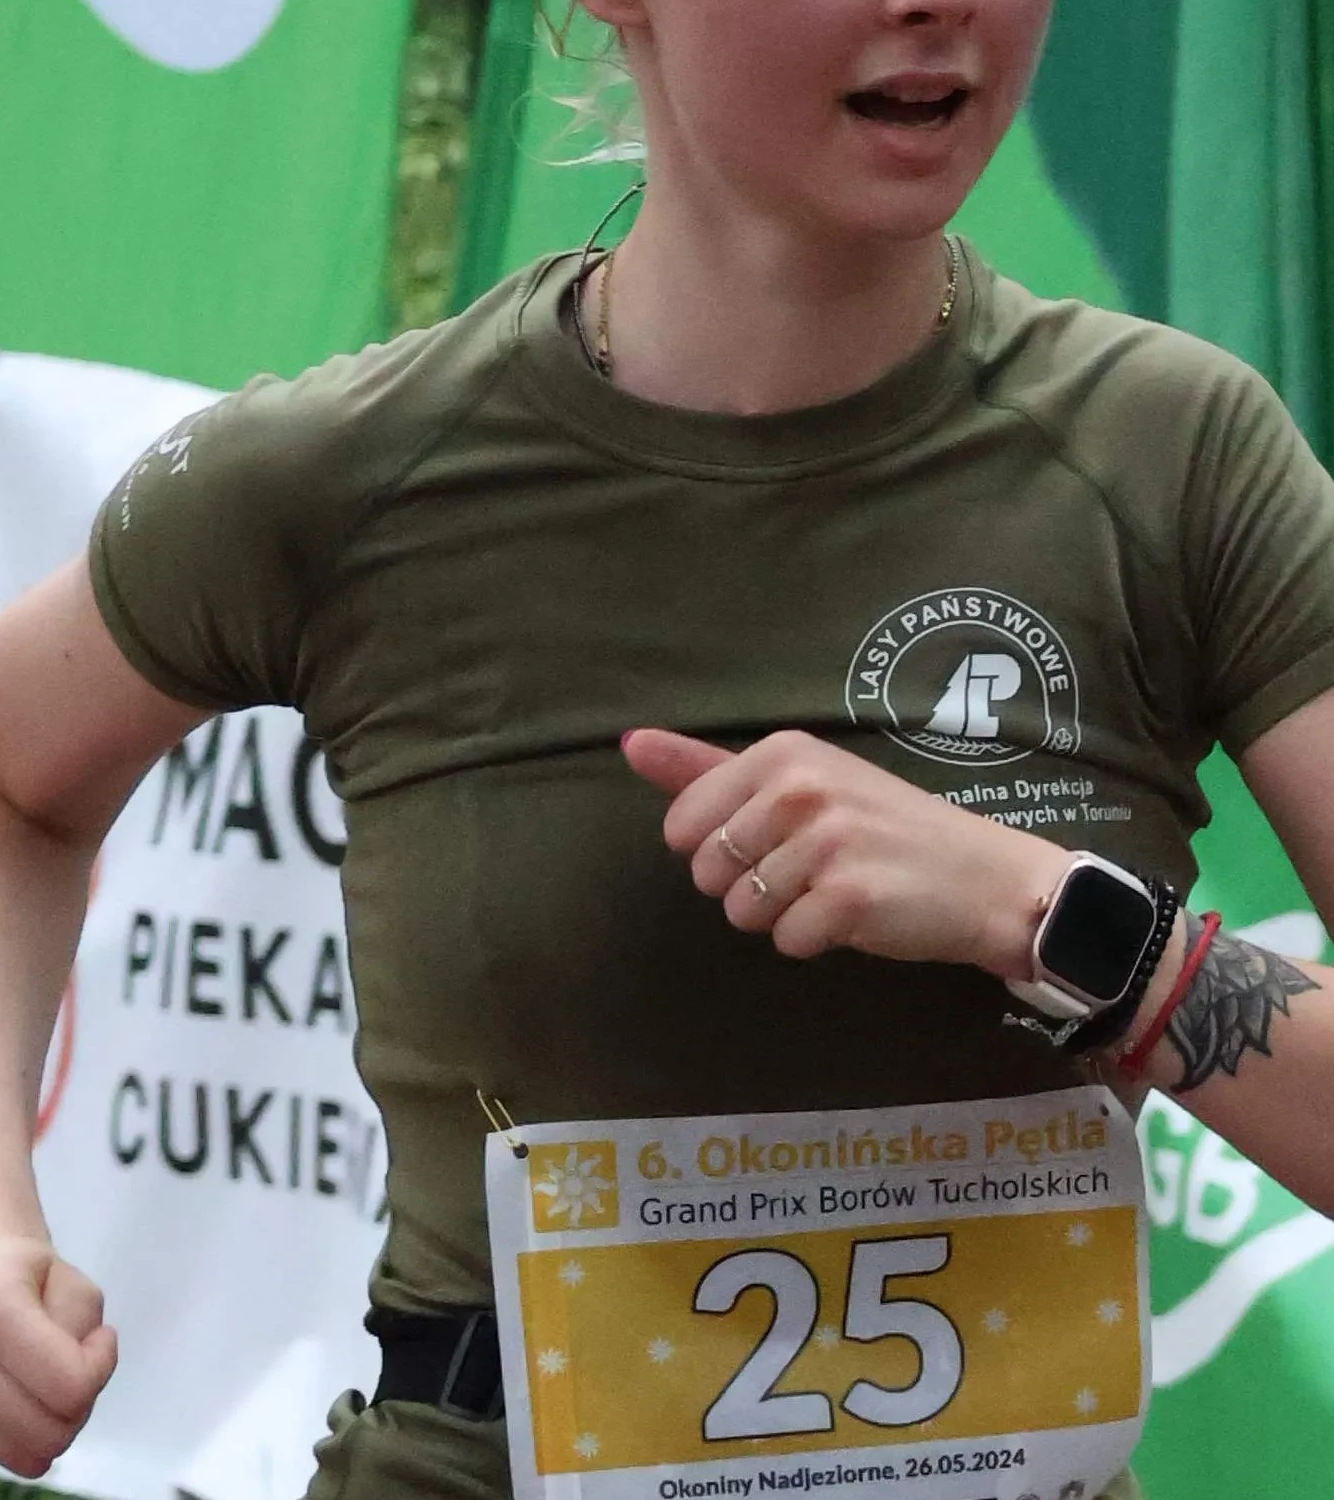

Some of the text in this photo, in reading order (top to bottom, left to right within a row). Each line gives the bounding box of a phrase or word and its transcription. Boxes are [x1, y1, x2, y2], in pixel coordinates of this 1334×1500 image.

[857, 595, 1069, 700] LASY PAŃSTWOWE
[982, 804, 1059, 828] owych
[1064, 808, 1077, 821] w
[1015, 777, 1094, 802] Dyrekcja
[110, 1068, 389, 1224] CUKIE
[636, 1110, 1108, 1181] 6. Okonińska Pętla
[640, 1165, 1109, 1227] Grand Prix Borów Tucholskich
[692, 1231, 965, 1444] 25
[659, 1447, 1027, 1500] Okoniny Nadjeziorne, 26.05.2024
